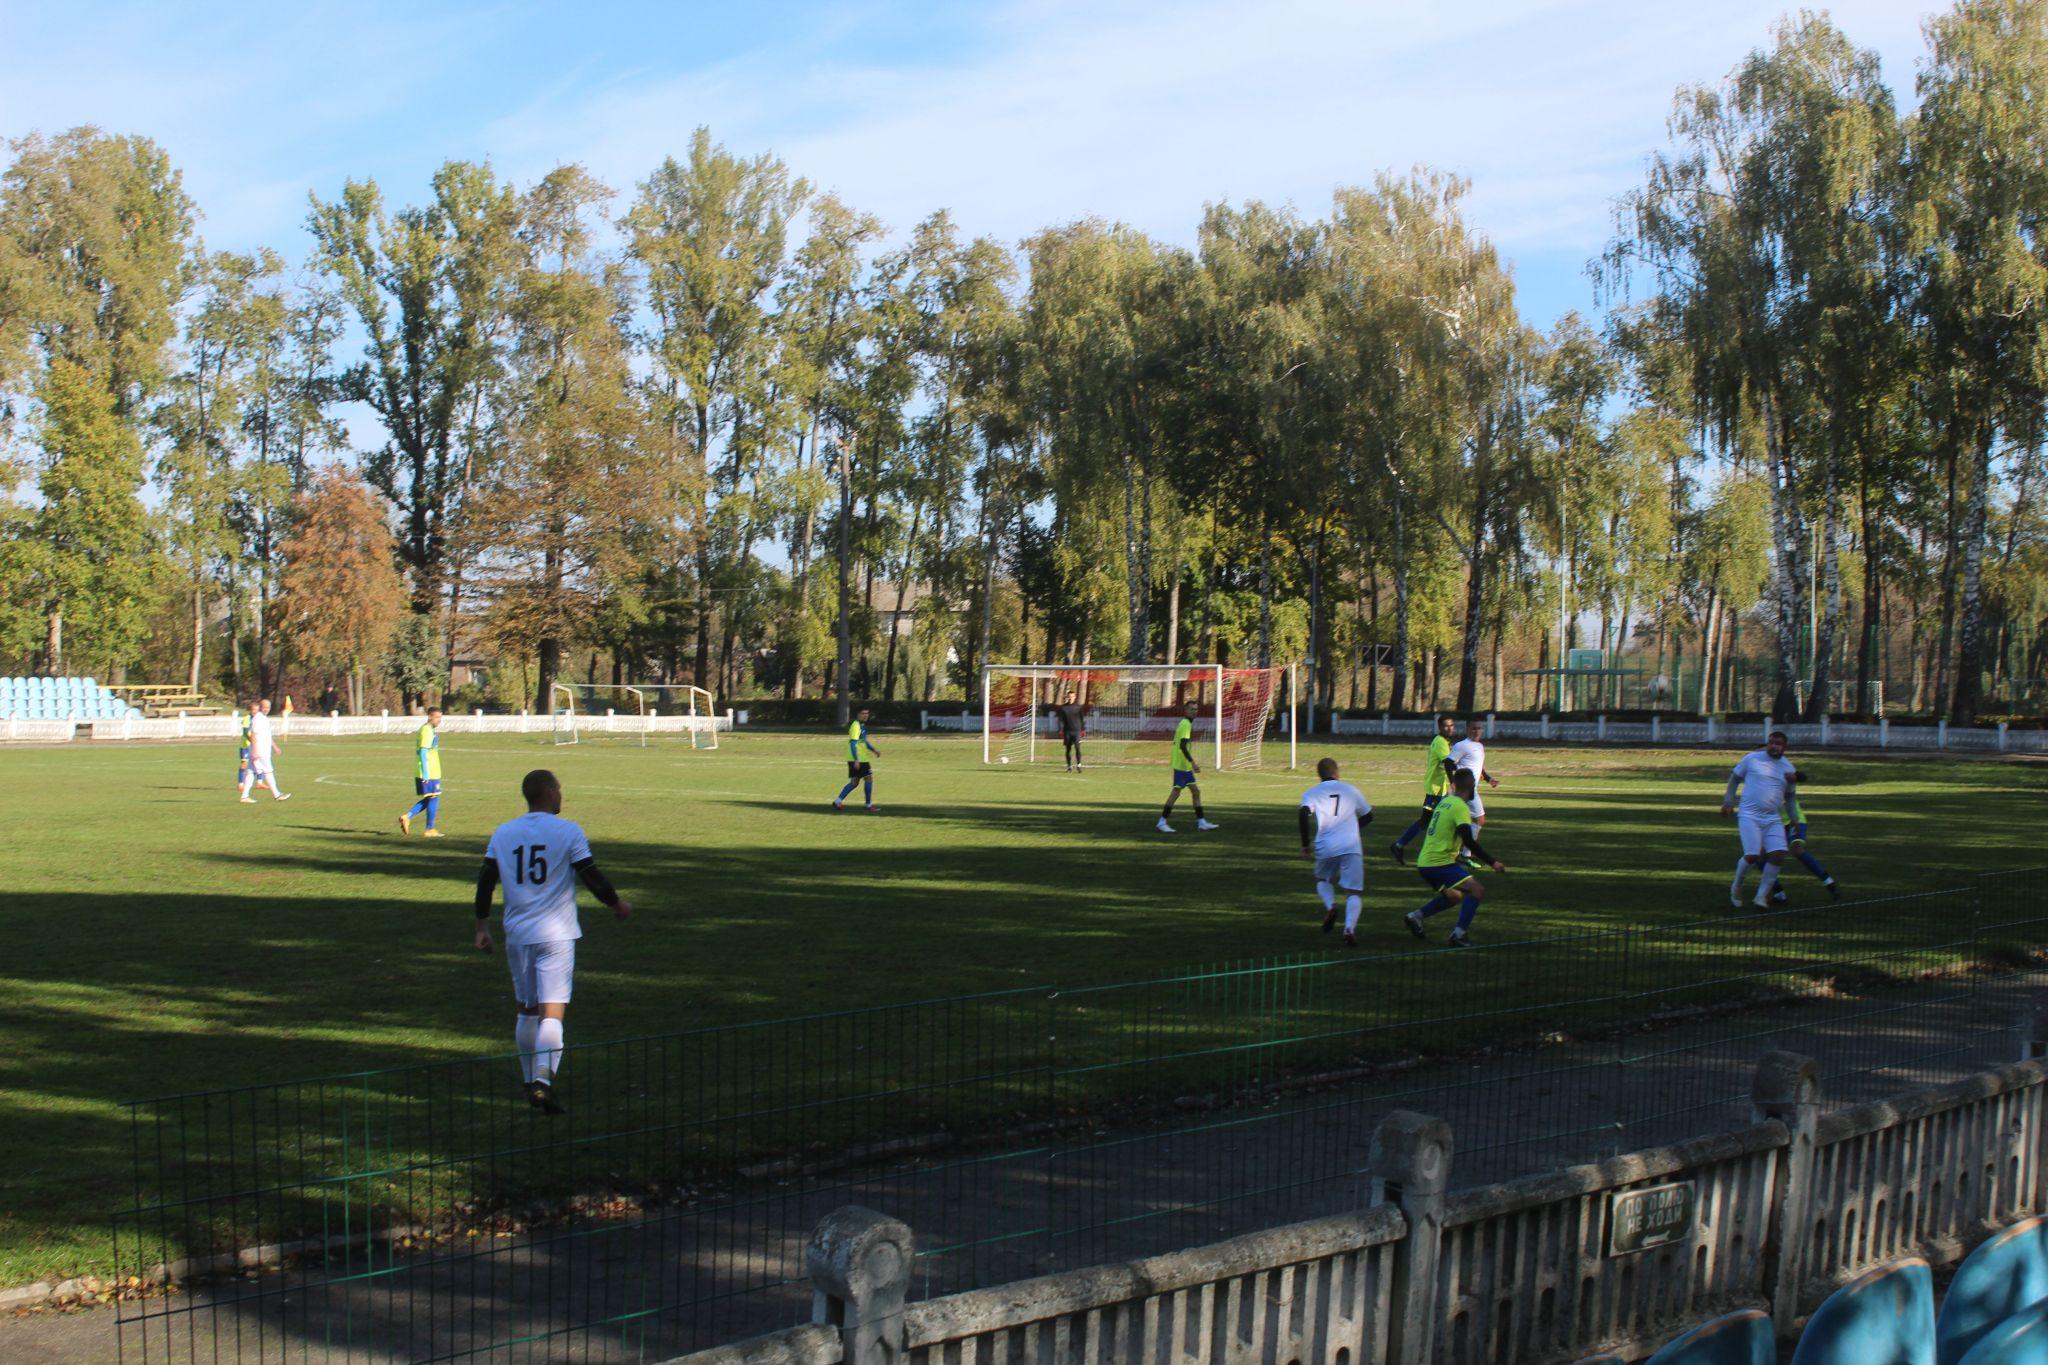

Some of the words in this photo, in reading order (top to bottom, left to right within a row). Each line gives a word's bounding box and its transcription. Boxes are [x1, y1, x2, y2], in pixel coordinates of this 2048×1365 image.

[1329, 794, 1340, 816] 7
[512, 845, 547, 885] 15
[1625, 1197, 1642, 1216] ПО
[1649, 1189, 1684, 1211] ПОЛЮ
[1627, 1216, 1643, 1234] НЕ
[1647, 1206, 1682, 1229] ХОДИ
